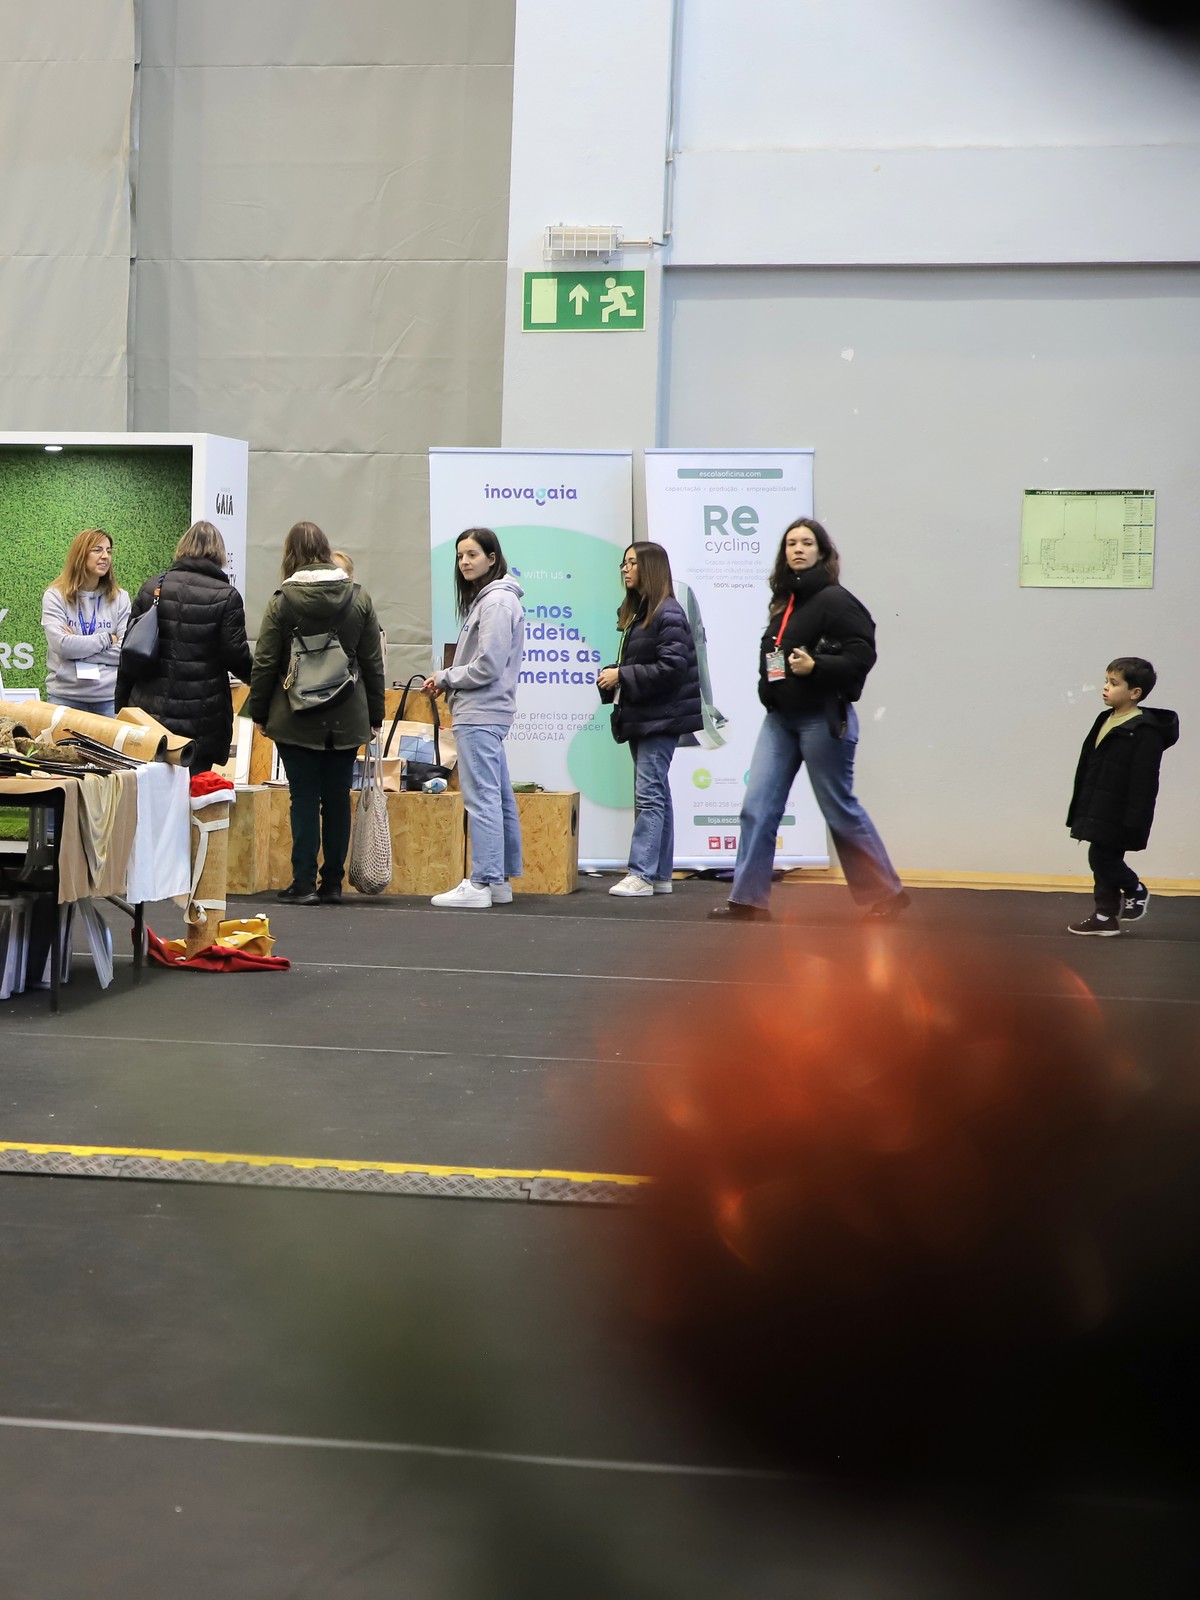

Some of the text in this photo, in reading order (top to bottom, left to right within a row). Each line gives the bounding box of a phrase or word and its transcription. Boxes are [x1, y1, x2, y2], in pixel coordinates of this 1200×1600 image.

[699, 470, 762, 478] escolaoficina.com
[484, 484, 577, 506] inovagaia
[708, 485, 738, 493] produção
[746, 485, 797, 493] empregabilidade
[216, 493, 234, 516] GAIA
[704, 538, 760, 554] cycling
[523, 569, 564, 580] with us
[524, 623, 587, 643] ideia,
[521, 649, 601, 663] emos as
[517, 669, 601, 685] mentas!
[514, 711, 595, 721] ue precisa para
[512, 721, 554, 733] negócio
[566, 723, 604, 731] crescer
[707, 816, 741, 824] loja.escol
